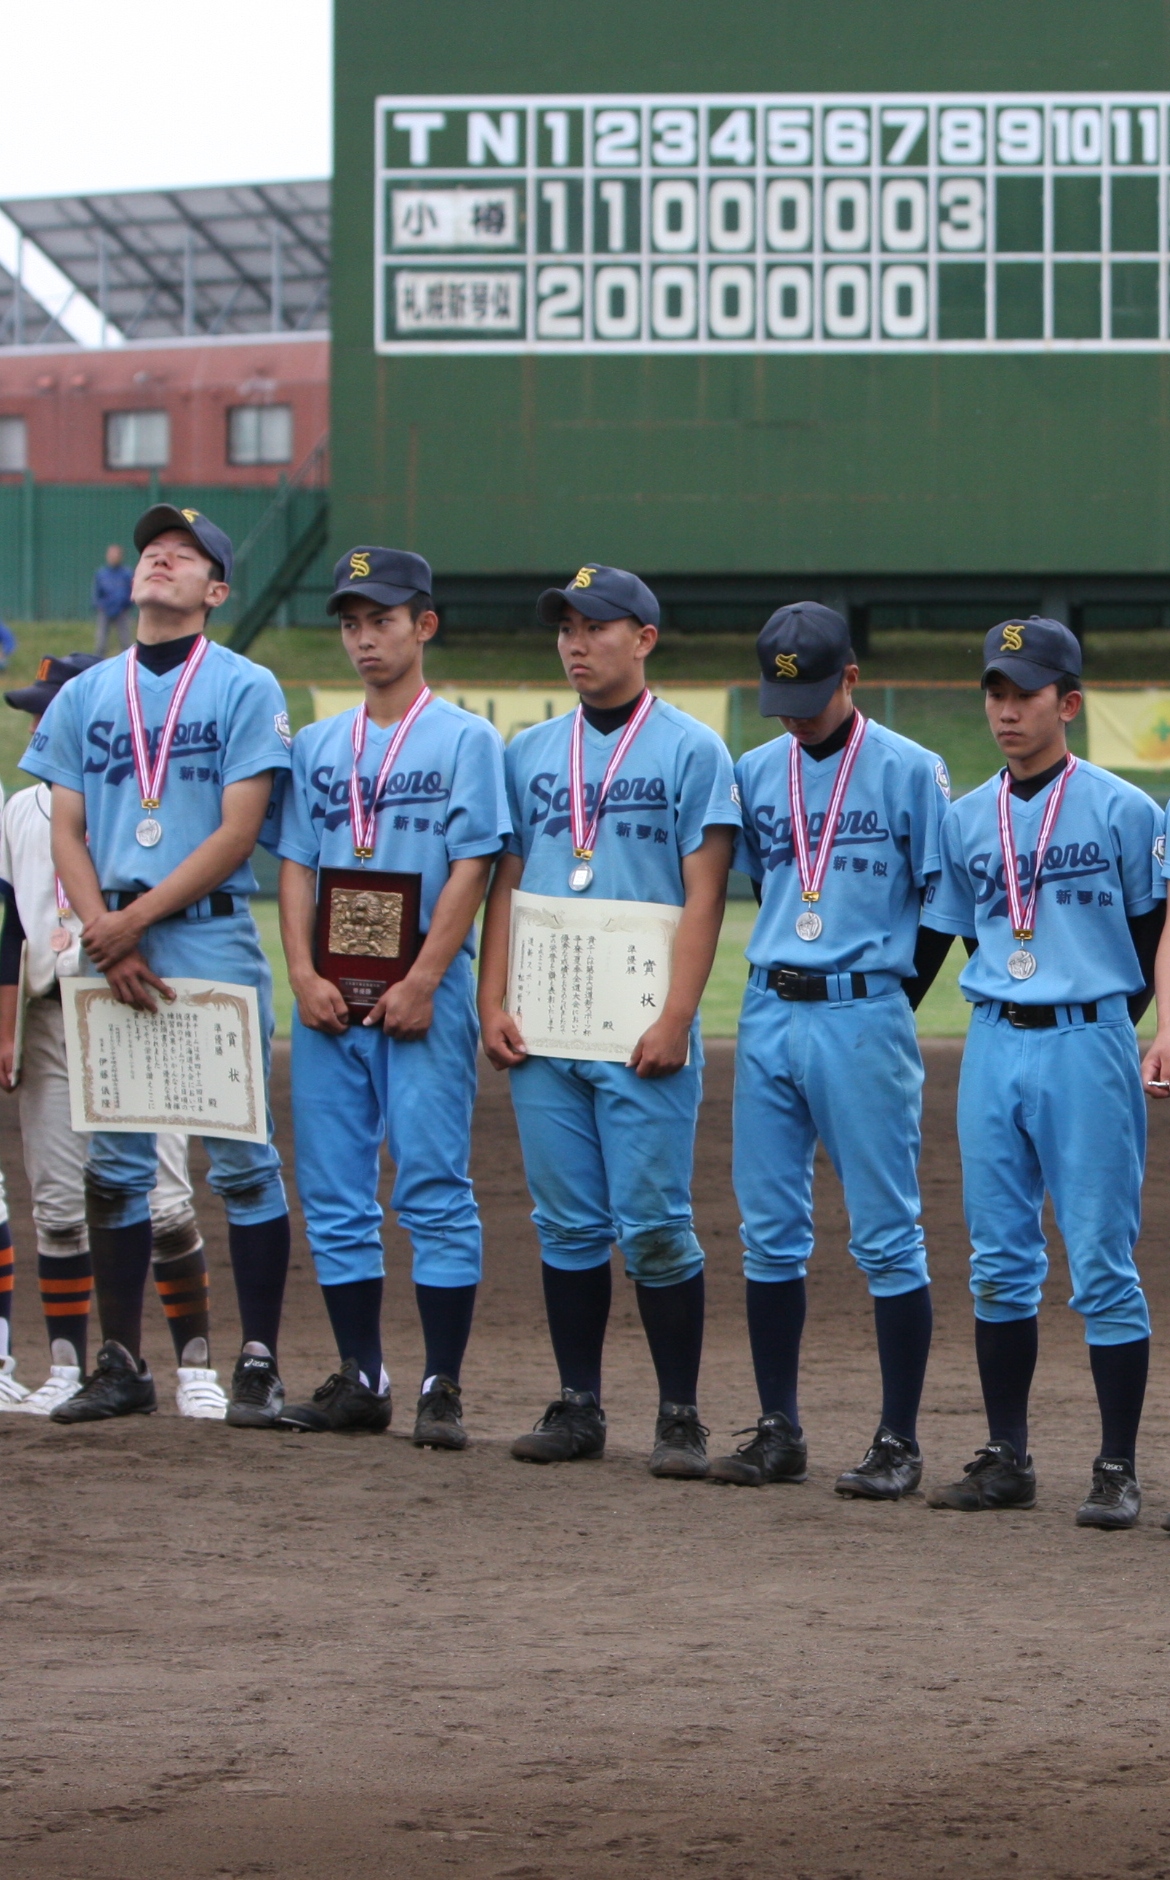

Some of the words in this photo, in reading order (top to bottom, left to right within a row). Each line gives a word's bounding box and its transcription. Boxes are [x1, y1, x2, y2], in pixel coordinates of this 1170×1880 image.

[544, 109, 569, 165] 1
[594, 109, 639, 165] 2
[652, 109, 697, 165] 3
[709, 109, 755, 165] 4
[766, 109, 812, 165] 5
[823, 109, 869, 165] 6
[881, 109, 927, 165] 7
[939, 109, 985, 165] 8
[997, 109, 1043, 165] 9
[1052, 109, 1102, 165] 10
[1112, 109, 1158, 165] 11
[542, 180, 567, 251] 1
[600, 180, 625, 251] 1
[652, 180, 697, 251] 0
[709, 180, 755, 251] 0
[766, 180, 812, 251] 0
[823, 180, 870, 251] 0
[881, 180, 927, 251] 0
[938, 180, 985, 251] 3
[537, 266, 583, 337] 2
[594, 266, 639, 337] 0
[652, 266, 697, 337] 0
[709, 266, 755, 337] 0
[766, 266, 812, 337] 0
[823, 266, 870, 337] 0
[881, 266, 927, 337] 0
[350, 552, 370, 579] S
[571, 566, 597, 590] S
[1000, 624, 1025, 651] S
[775, 653, 798, 678] S
